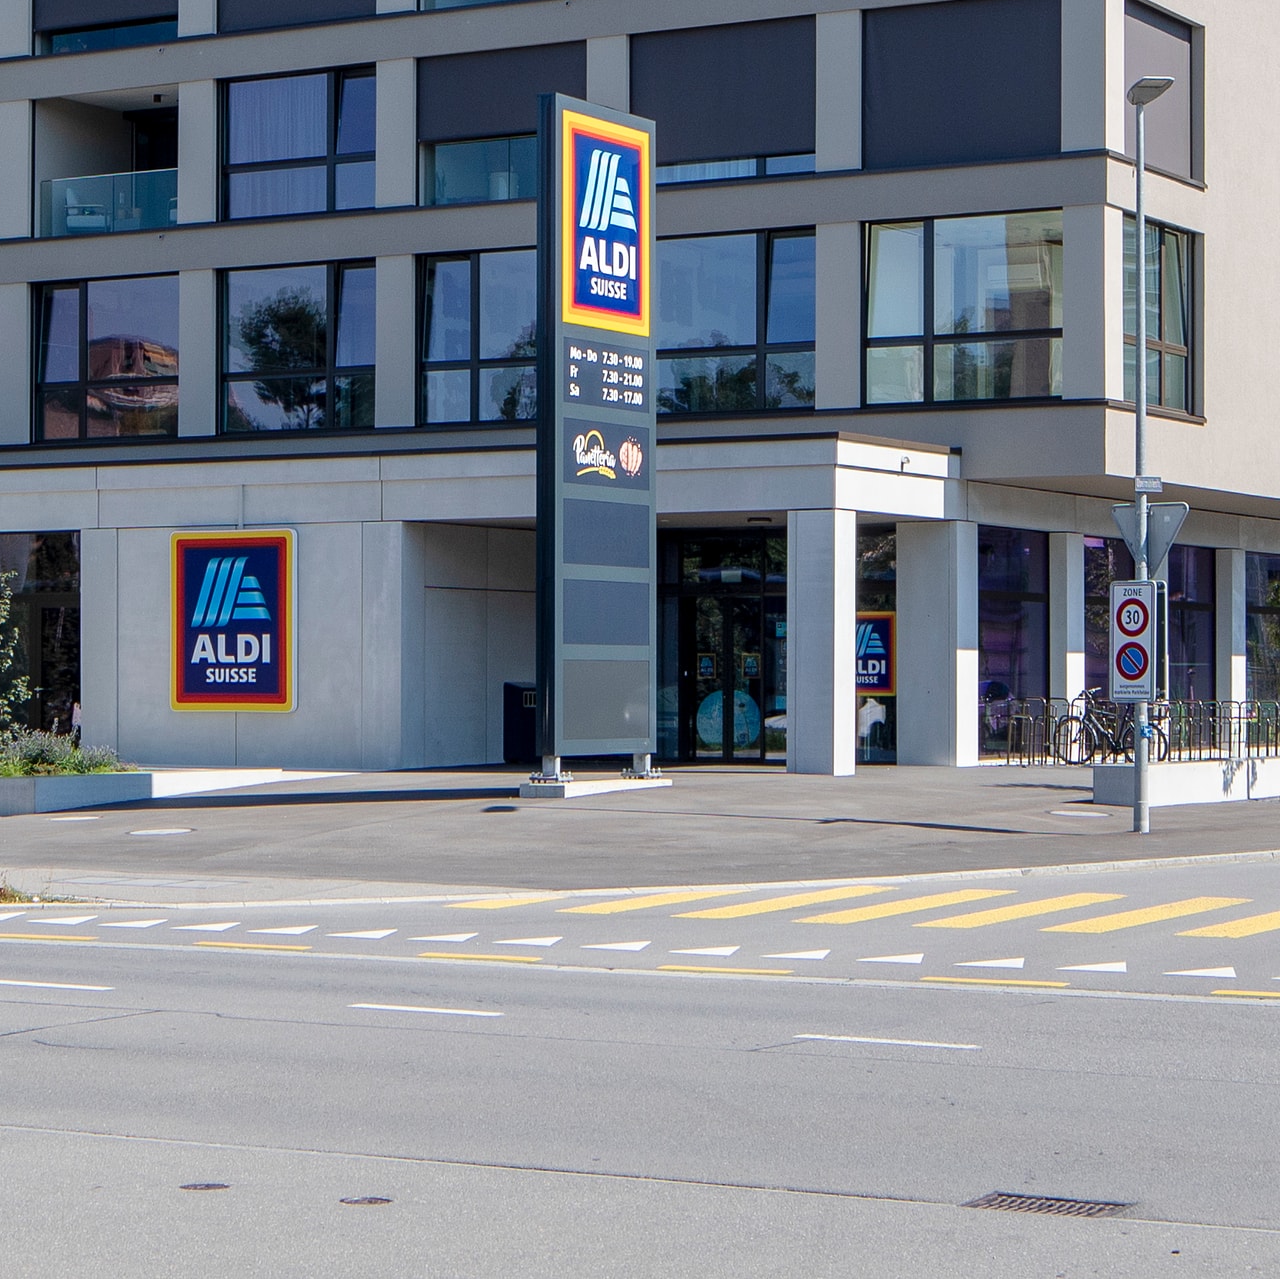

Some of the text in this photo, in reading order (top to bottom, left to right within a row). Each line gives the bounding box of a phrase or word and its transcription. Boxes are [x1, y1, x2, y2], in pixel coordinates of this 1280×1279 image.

[579, 235, 636, 280] ALDI
[590, 276, 627, 300] SUISSE
[602, 351, 618, 366] 7.30
[623, 355, 643, 370] 19.00
[570, 364, 579, 378] Fr
[602, 369, 618, 384] 7.30
[623, 372, 643, 388] 21.00
[569, 382, 580, 397] Sa
[602, 387, 618, 402] 7.30
[623, 390, 643, 405] 17.00
[1123, 588, 1143, 597] ZONE
[1125, 610, 1140, 625] 30
[191, 633, 270, 664] ALDI
[206, 668, 257, 683] SUISSE
[856, 660, 886, 675] LDI
[856, 675, 879, 684] UISSE
